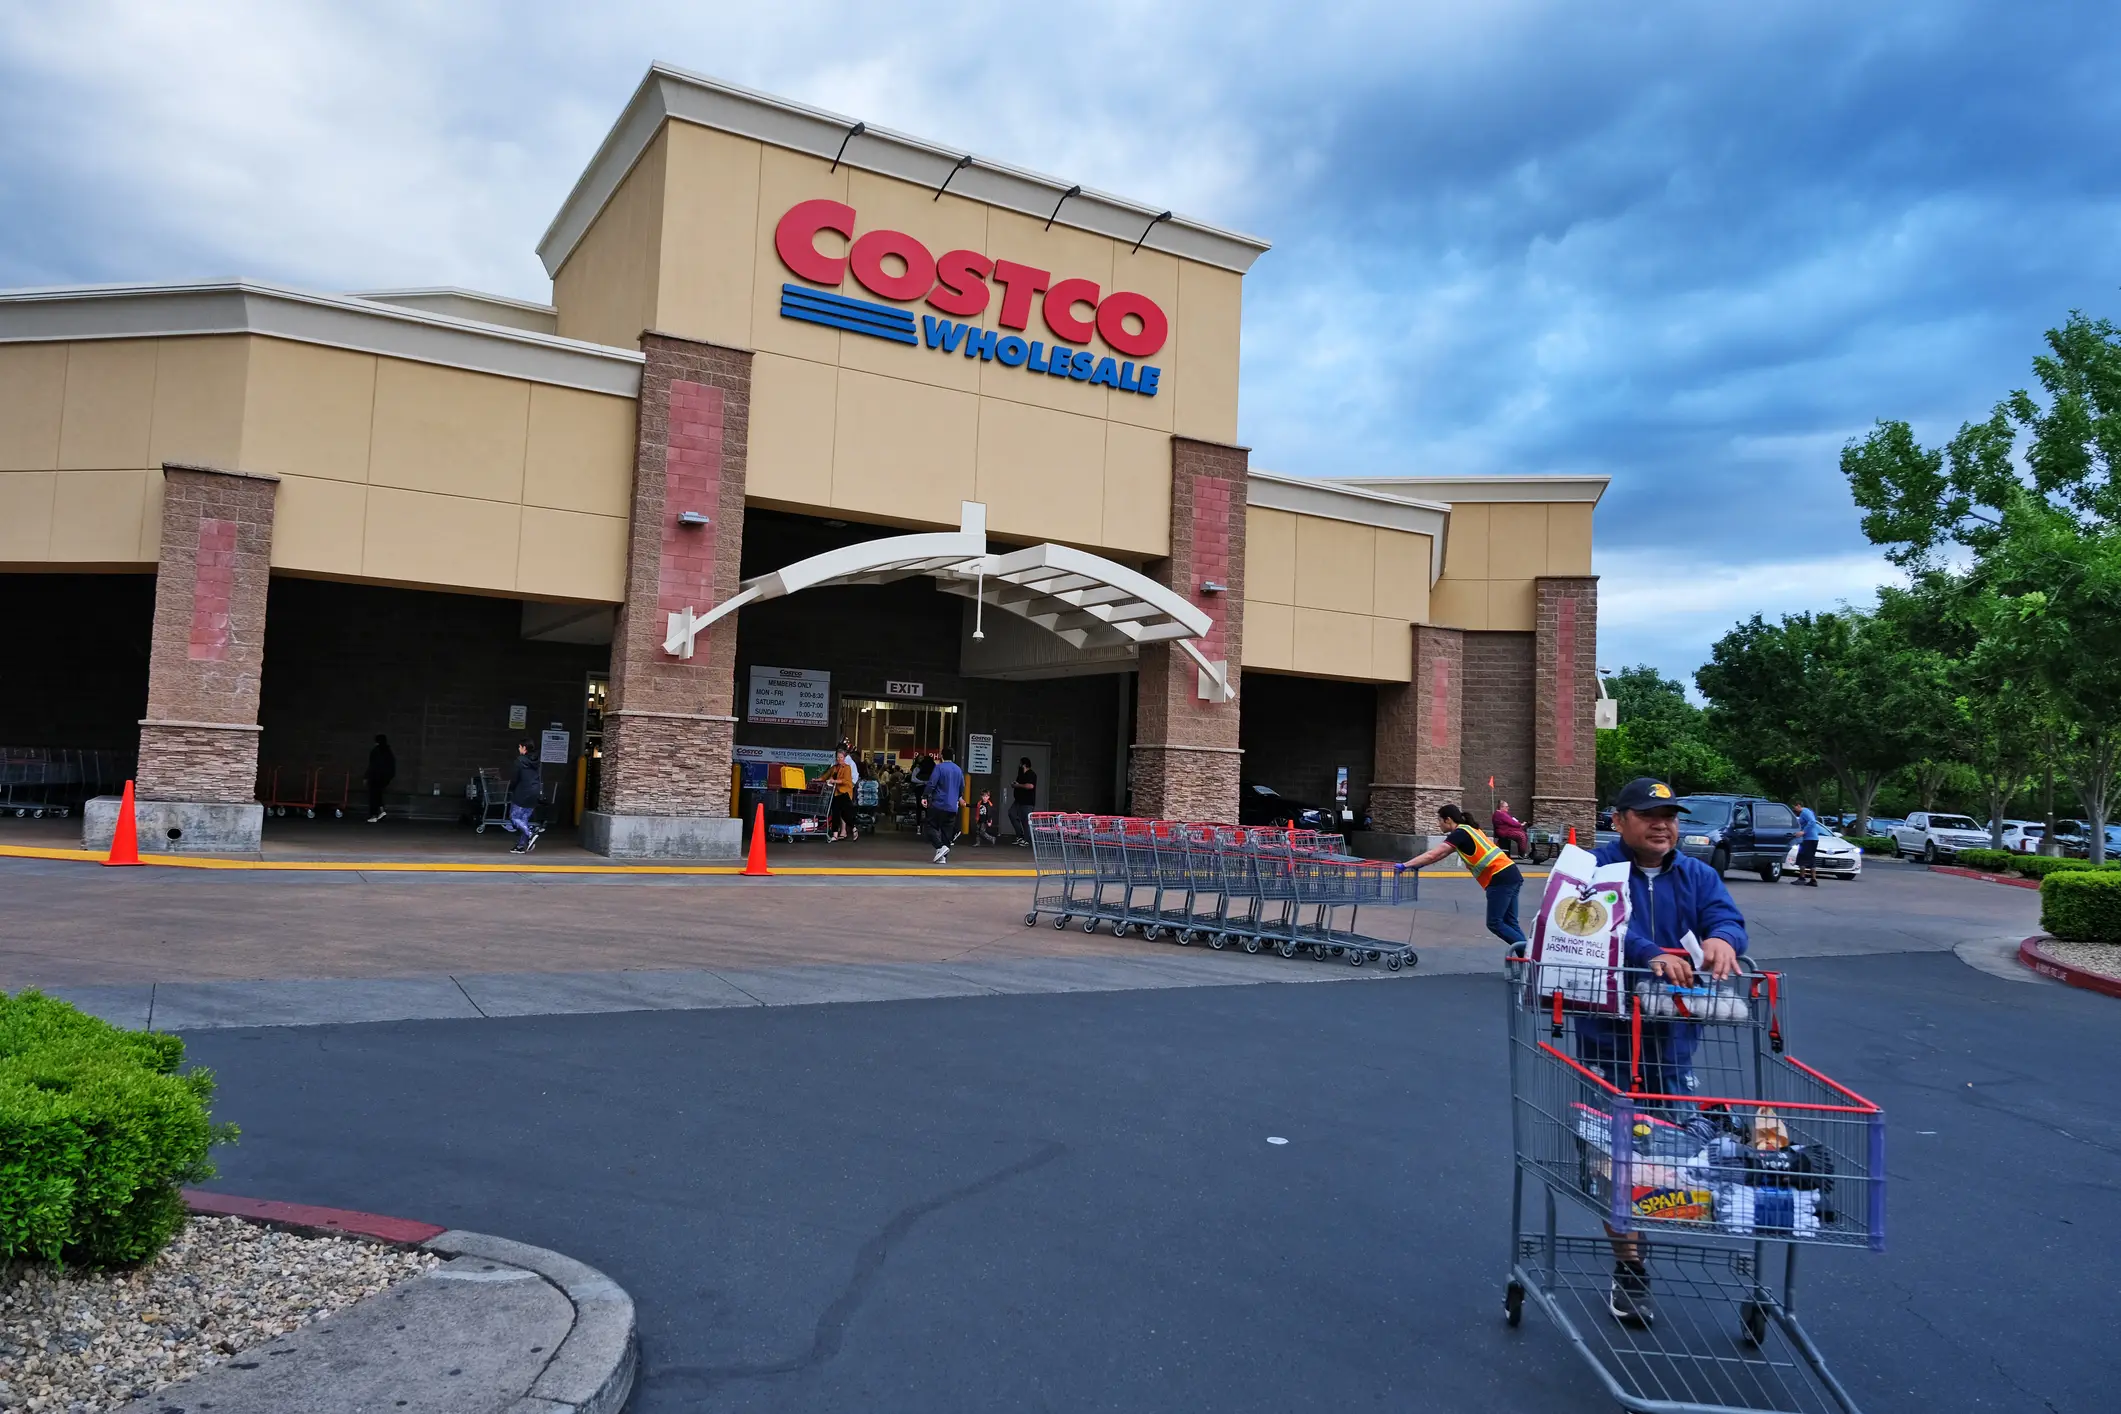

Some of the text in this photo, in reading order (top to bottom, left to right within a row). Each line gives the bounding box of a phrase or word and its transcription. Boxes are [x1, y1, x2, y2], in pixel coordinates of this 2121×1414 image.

[775, 199, 1168, 356] COSTCO
[923, 314, 1161, 396] WHOLESALE
[768, 680, 797, 688] MEMBERS
[890, 683, 919, 694] EXIT
[755, 698, 823, 709] SATURDAY 9:00-7:00
[1551, 935, 1604, 949] THAI HOM MALI
[1546, 943, 1606, 959] JASMINE RICE
[1638, 1191, 1687, 1214] SPAM
